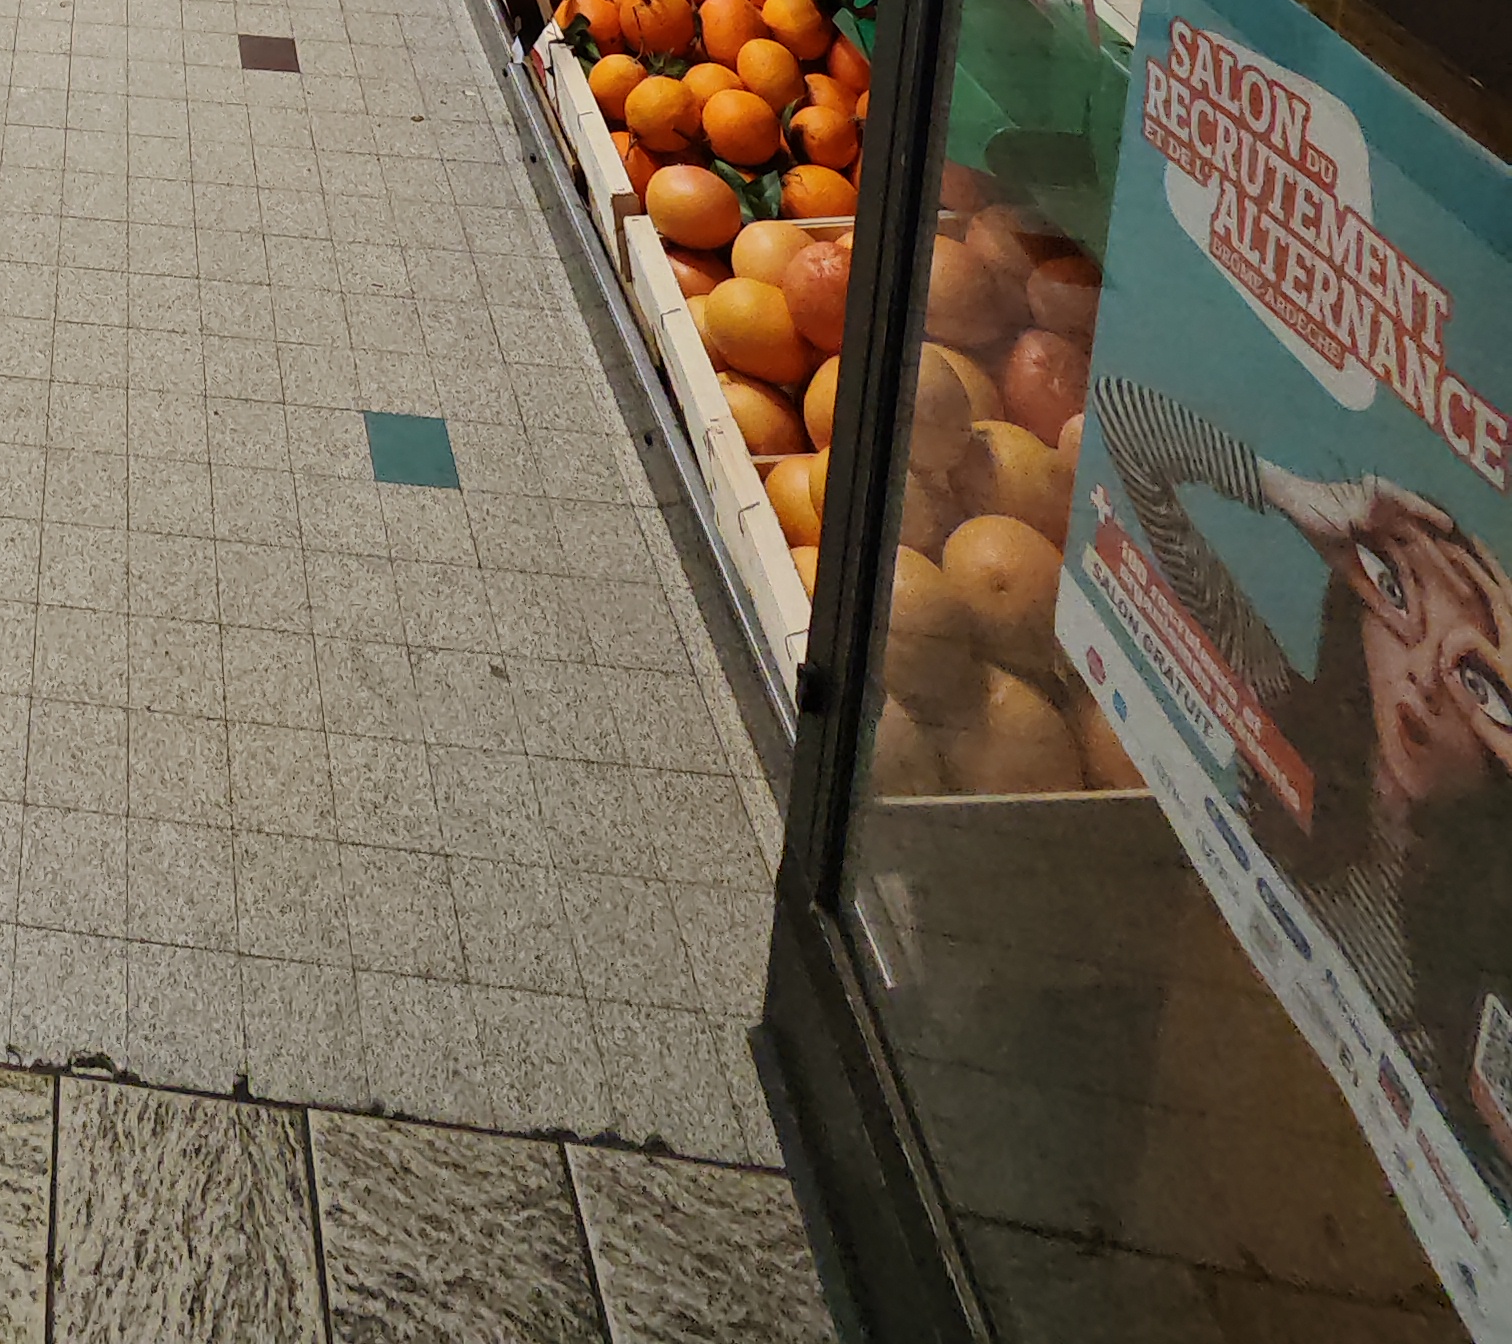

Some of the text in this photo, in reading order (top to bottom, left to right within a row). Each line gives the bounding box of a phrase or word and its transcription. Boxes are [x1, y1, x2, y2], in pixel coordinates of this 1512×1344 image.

[1145, 121, 1166, 148] ET
[1167, 138, 1191, 171] DE
[1169, 20, 1336, 184] SALON DU
[1145, 59, 1449, 358] RECRUTEMENT
[1214, 181, 1508, 492] ALTERNANCE
[1091, 561, 1140, 637] SALON
[1141, 632, 1216, 738] GRATUIT
